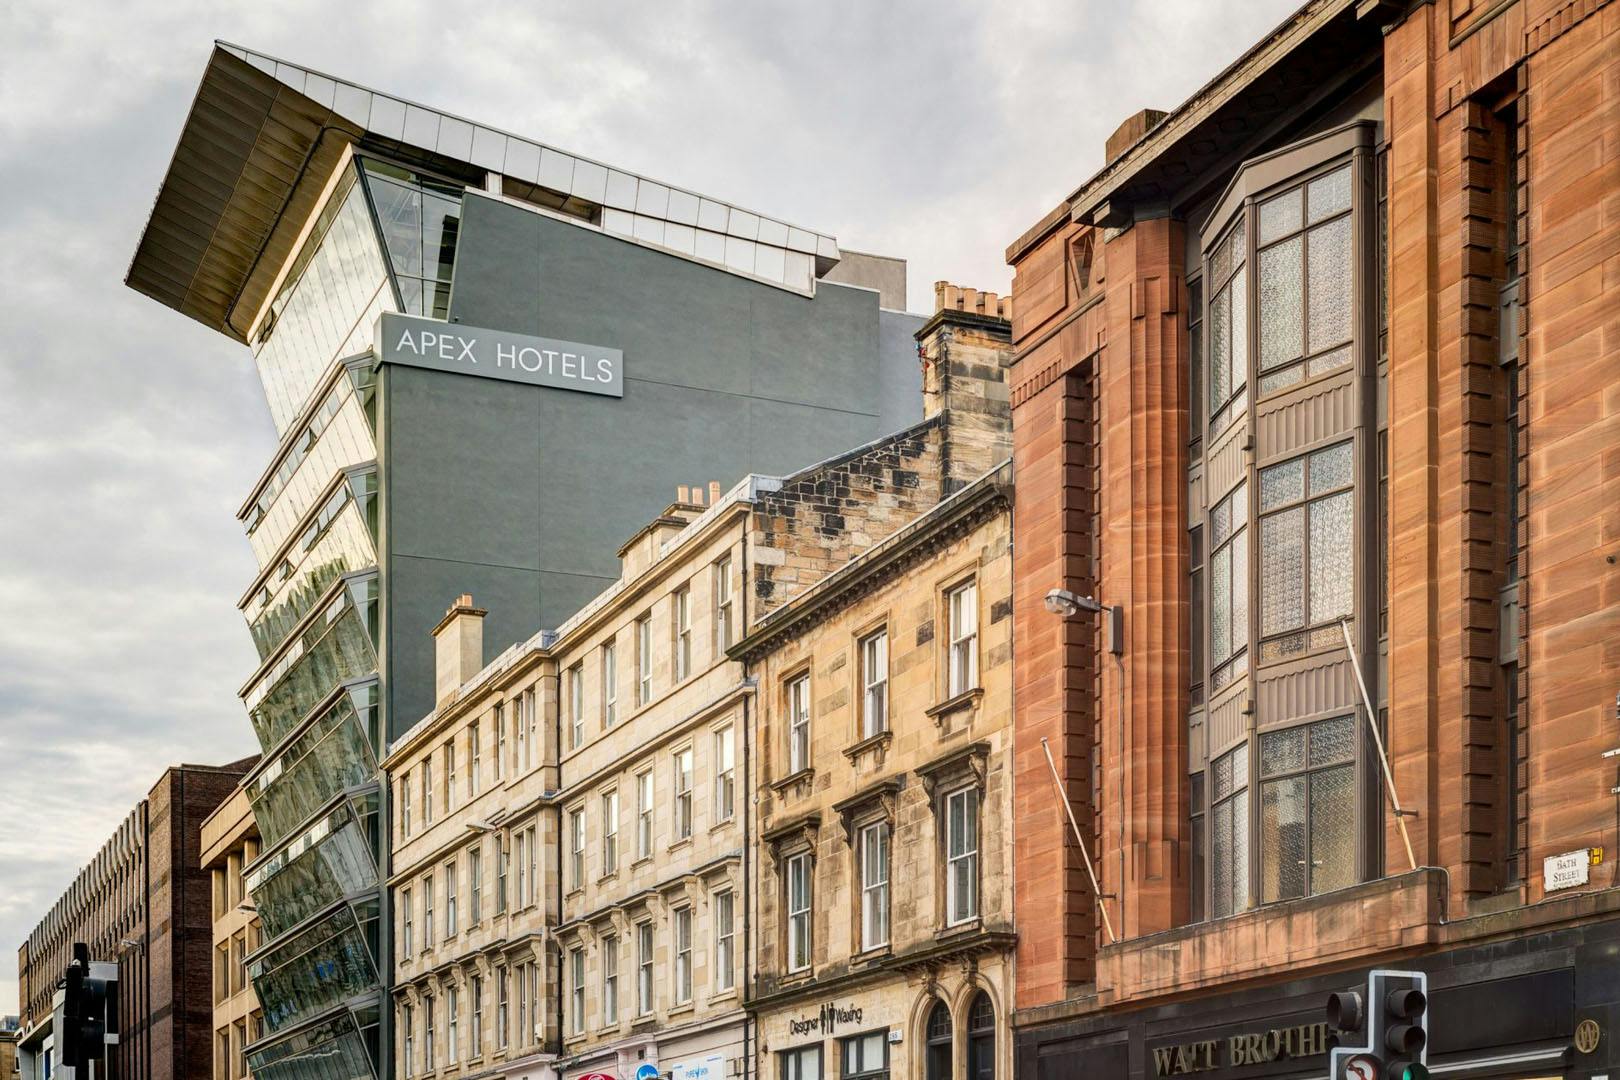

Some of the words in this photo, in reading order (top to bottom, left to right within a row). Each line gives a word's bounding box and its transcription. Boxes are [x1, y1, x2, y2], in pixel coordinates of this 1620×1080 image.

[396, 328, 477, 364] APEX
[496, 343, 613, 384] HOTELS
[1553, 869, 1580, 882] STREET
[1557, 858, 1577, 870] BATH
[790, 1014, 819, 1036] Designer
[835, 1003, 863, 1025] Waxing
[1152, 1040, 1219, 1077] WATT
